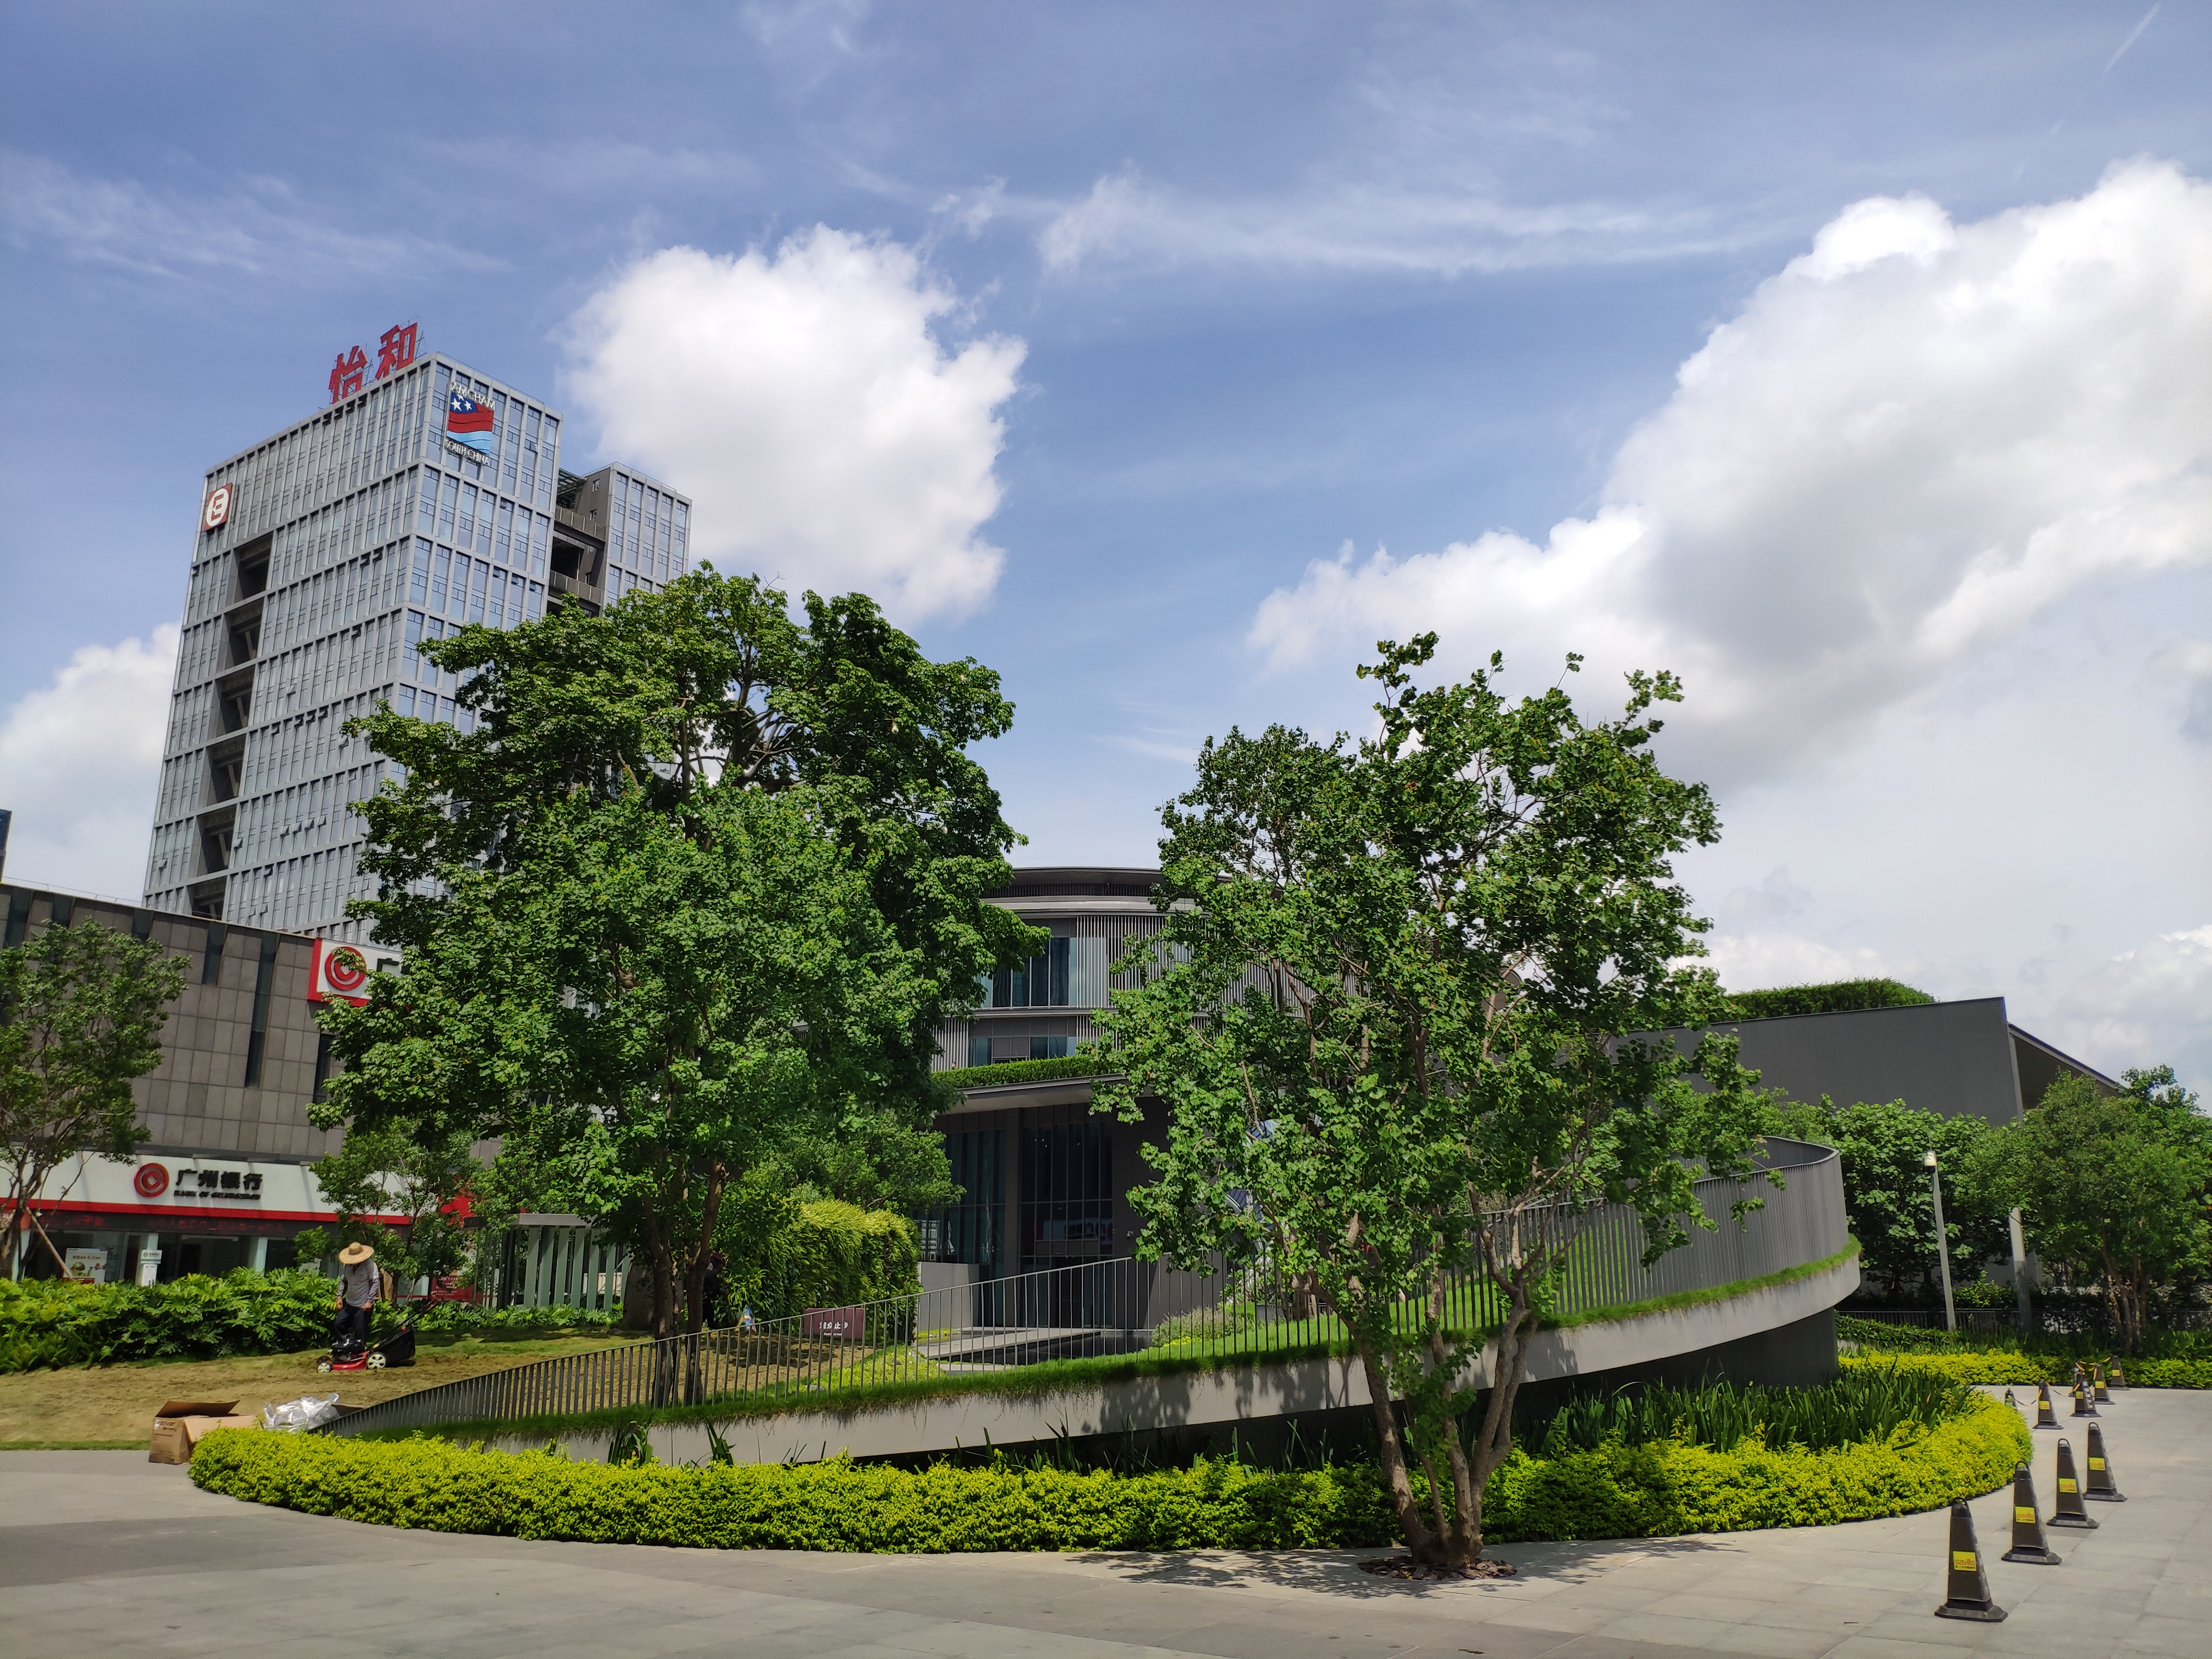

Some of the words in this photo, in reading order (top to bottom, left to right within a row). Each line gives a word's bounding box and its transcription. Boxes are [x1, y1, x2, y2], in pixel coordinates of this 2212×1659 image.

[329, 322, 418, 404] 怡和
[451, 382, 495, 410] AMCHAM
[444, 439, 467, 456] SOUTH
[467, 449, 490, 466] CHINA
[176, 1169, 263, 1190] 广州银行
